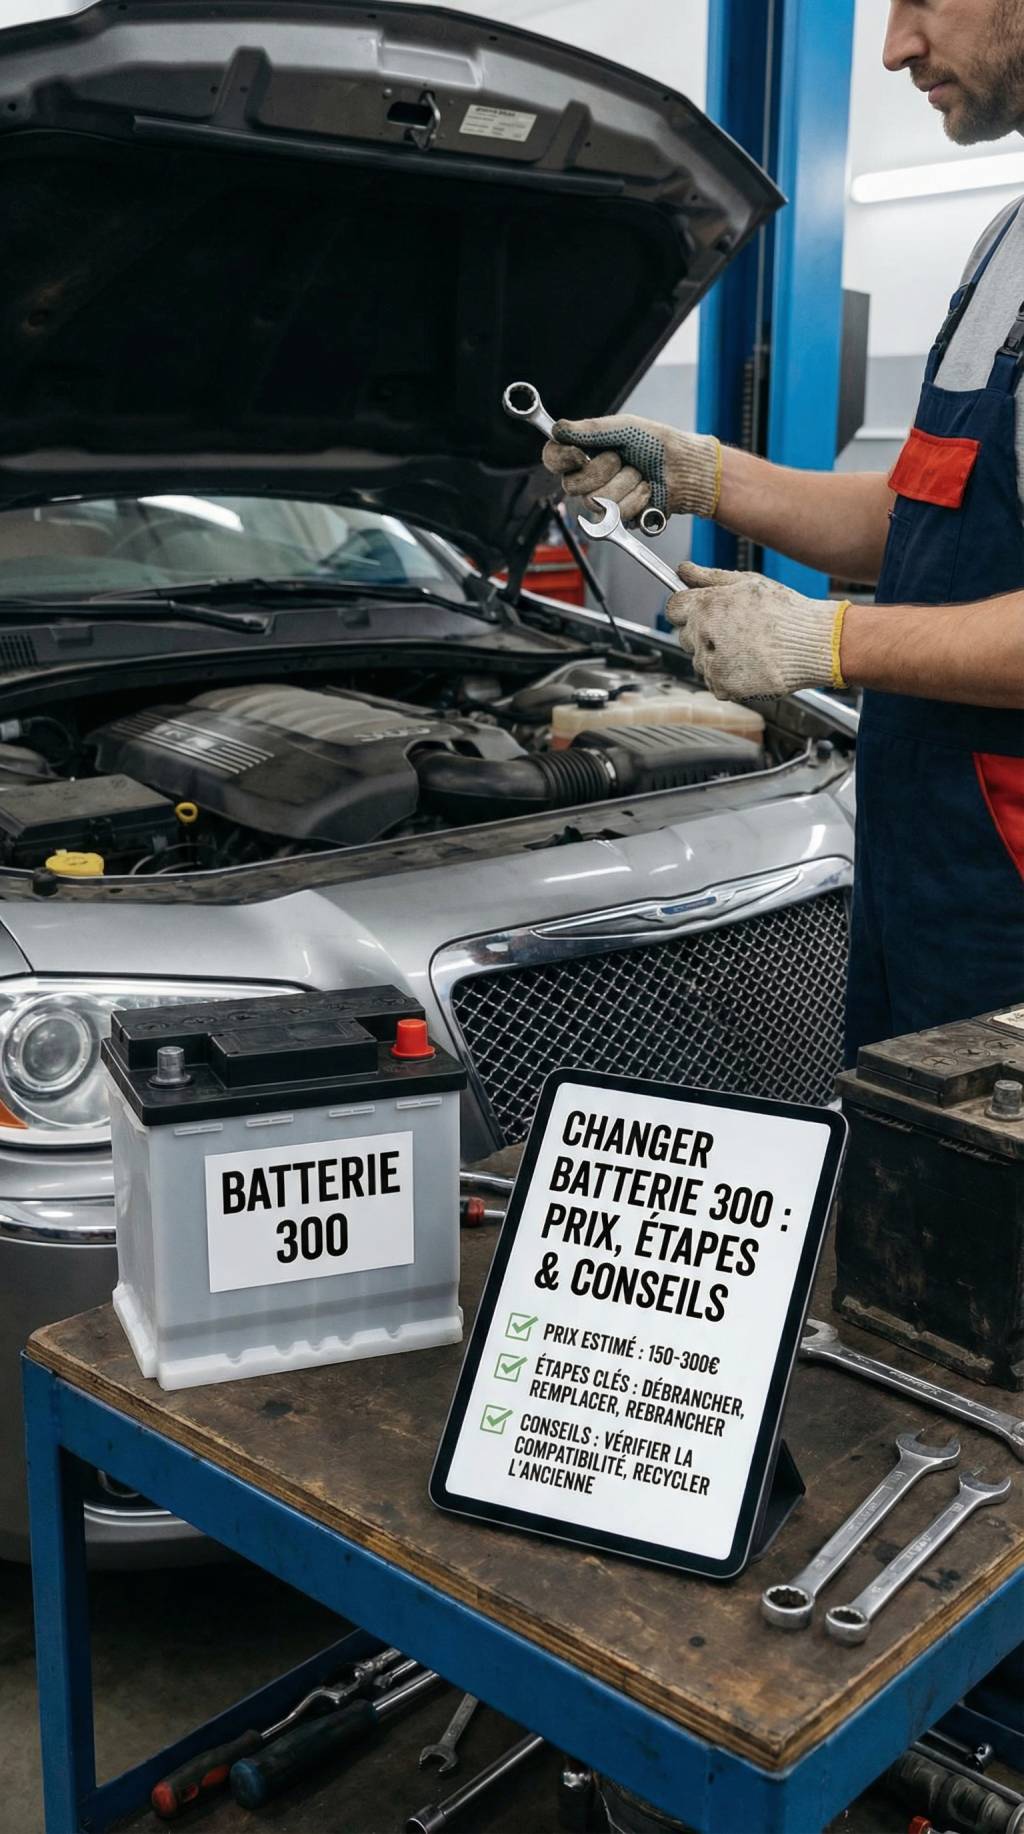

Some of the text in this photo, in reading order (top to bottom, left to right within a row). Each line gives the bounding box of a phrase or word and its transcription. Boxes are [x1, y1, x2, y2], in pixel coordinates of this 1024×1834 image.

[562, 1111, 714, 1169] CHANGER
[223, 1151, 401, 1214] BATTERIE
[549, 1156, 704, 1216] BATTERIE
[709, 1183, 774, 1229] 300
[276, 1213, 349, 1264] 300
[541, 1203, 760, 1277] PRIX, ÉTAPES
[534, 1252, 729, 1323] & CONSEILS
[543, 1323, 578, 1347] PRIX
[580, 1330, 637, 1359] ESTIMÉ
[648, 1345, 721, 1376] 150-300€
[529, 1379, 726, 1438] REMPLACER, REBRANCHER
[535, 1355, 591, 1385] ÉTAPES
[592, 1368, 631, 1394] CLÉS
[641, 1379, 746, 1421] DÉBRANCHER,
[514, 1435, 711, 1496] COMPATIBILITÉ, RECYCLER
[519, 1413, 593, 1445] CONSEILS
[604, 1429, 671, 1463] VÉRIFIER
[674, 1446, 693, 1468] LA
[508, 1458, 596, 1496] L'ANCIENNE
